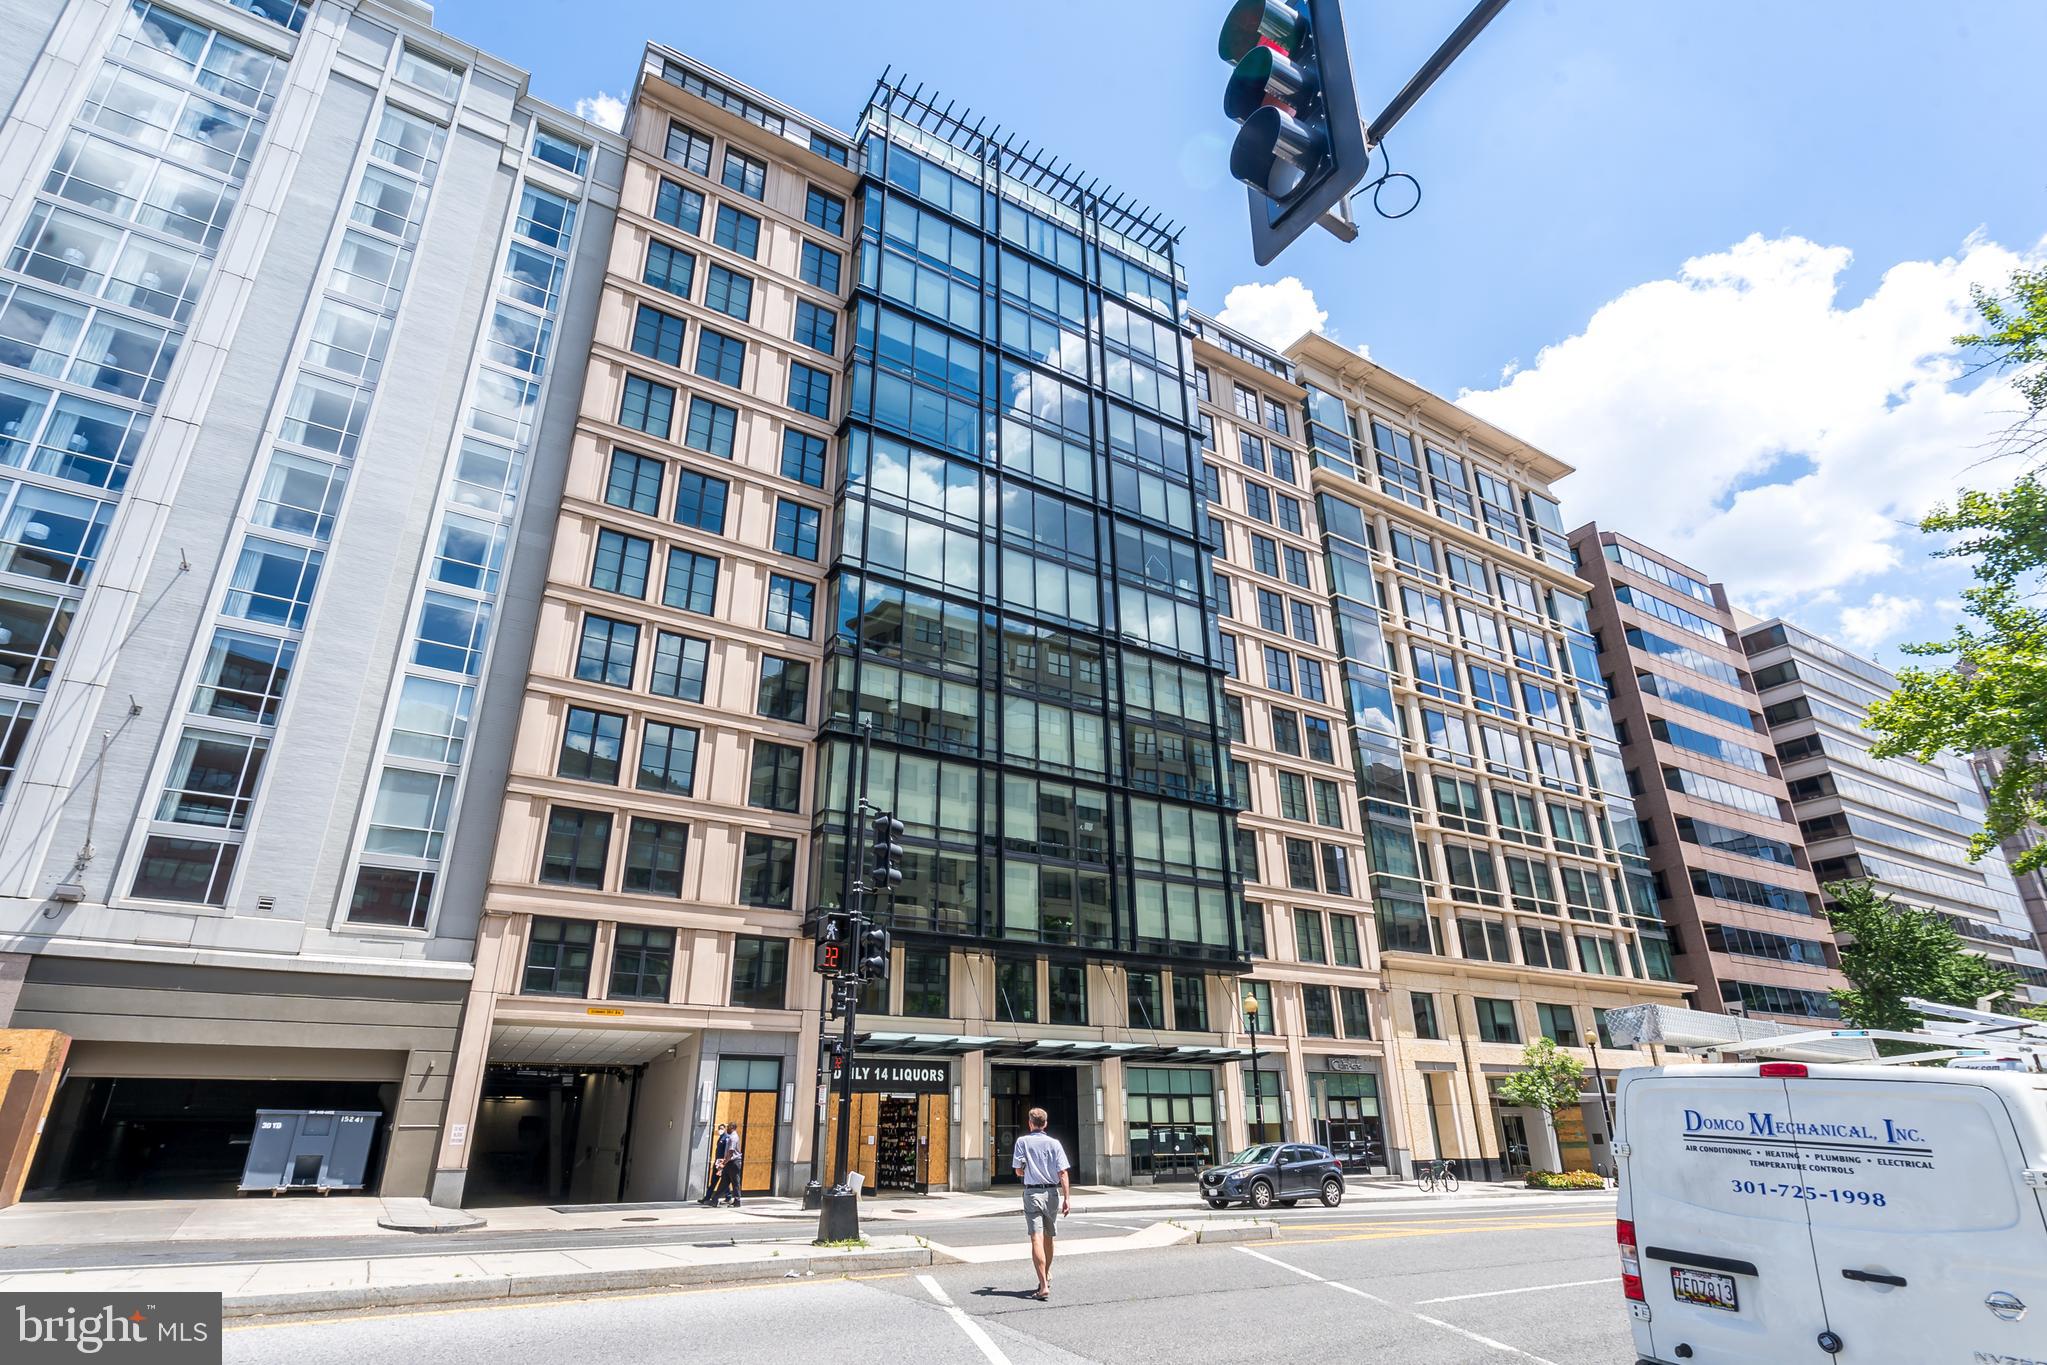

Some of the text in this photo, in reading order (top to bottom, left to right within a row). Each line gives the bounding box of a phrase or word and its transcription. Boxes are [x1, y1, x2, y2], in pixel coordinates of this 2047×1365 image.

[833, 1067, 944, 1082] DILY 14 LIQUORS
[1699, 1146, 1752, 1156] CONDITIONING
[1765, 1150, 1800, 1159] HEATING
[1814, 1154, 1861, 1164] PLUMBING
[1877, 1158, 1935, 1169] ELECTRICAL
[1749, 1160, 1855, 1175] TEMPERATURE CONTROLS
[1731, 1179, 1887, 1208] 301-725-1998
